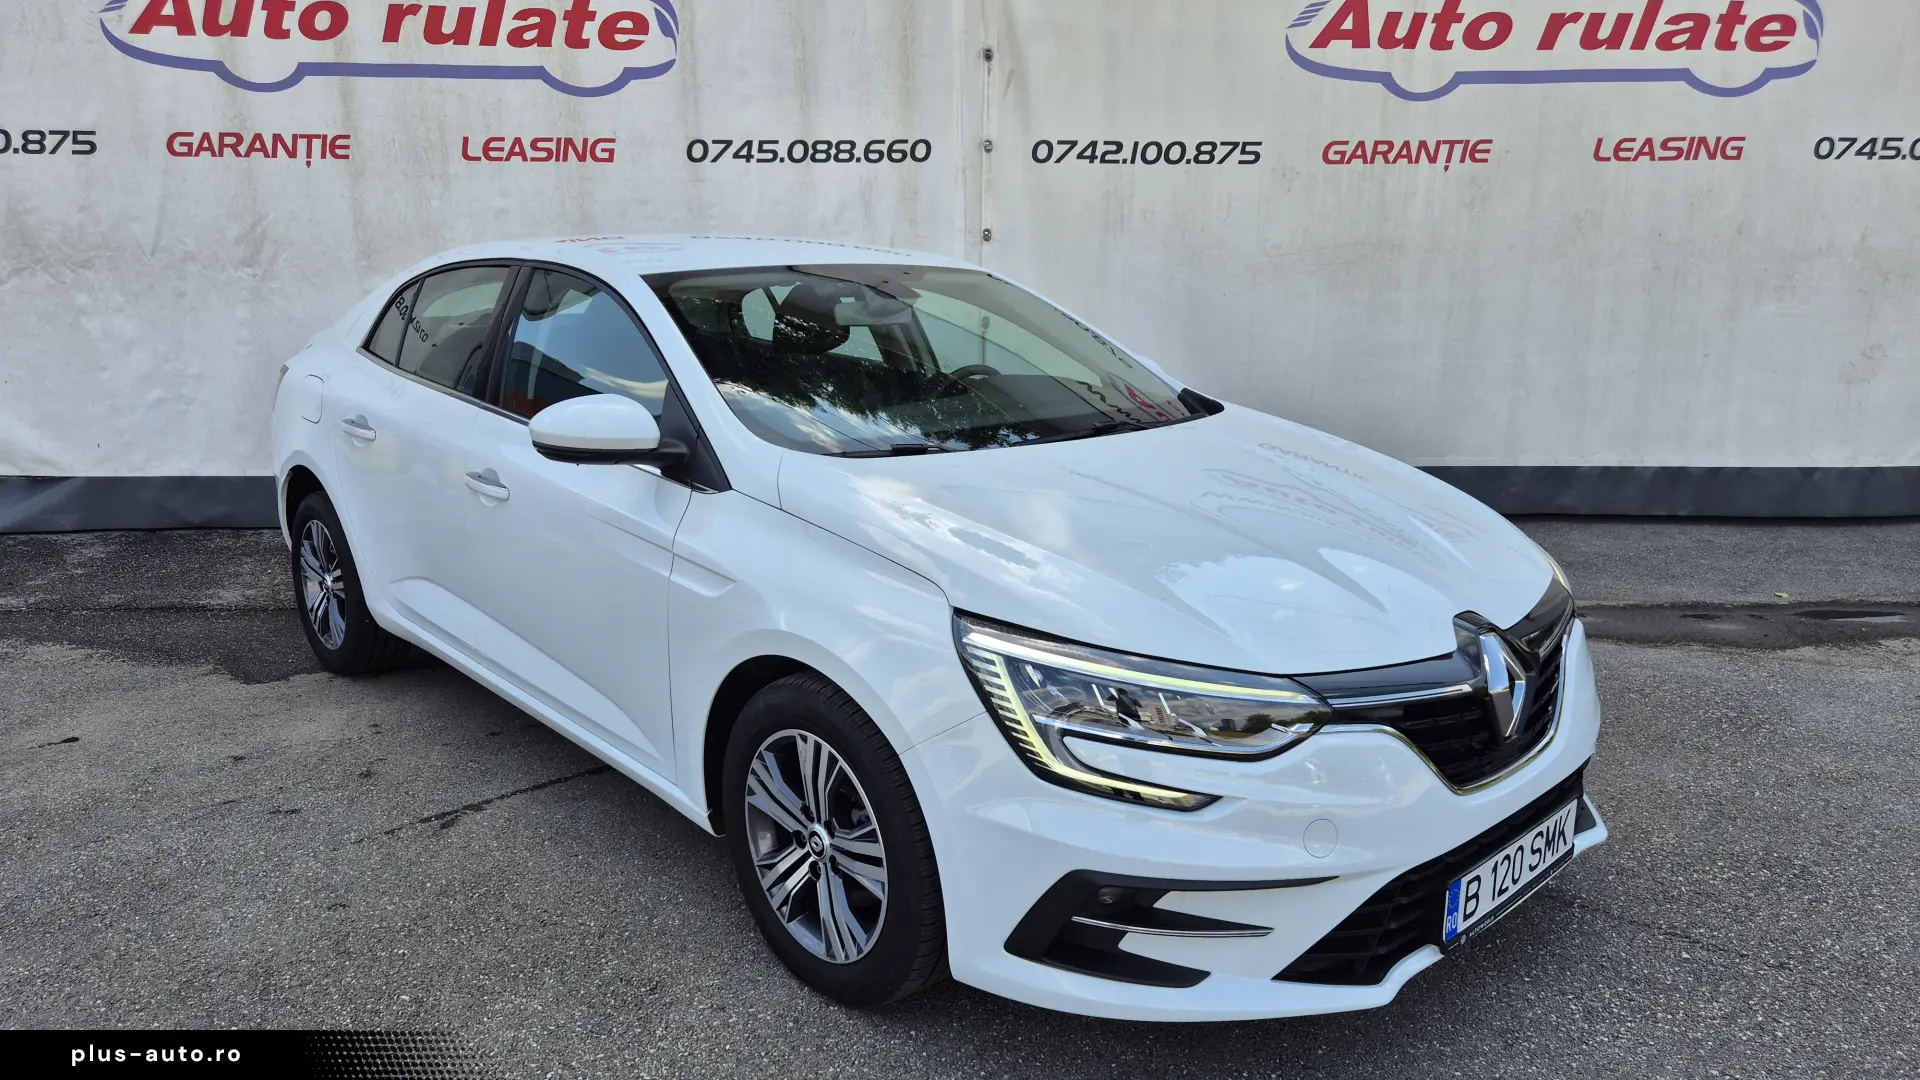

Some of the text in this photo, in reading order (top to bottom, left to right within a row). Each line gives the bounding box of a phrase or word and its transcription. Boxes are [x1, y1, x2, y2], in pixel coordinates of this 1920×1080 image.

[128, 0, 651, 51] Auto rulate
[1309, 0, 1798, 53] Auto rulate
[461, 136, 617, 163] LEASING
[686, 138, 932, 164] 0745.088.660
[1031, 140, 1263, 165] 0742.100.875
[1593, 136, 1746, 163] LEASING
[1463, 874, 1482, 923] B
[1491, 844, 1525, 902] 120
[1529, 808, 1571, 872] SMK
[1446, 911, 1458, 934] RO
